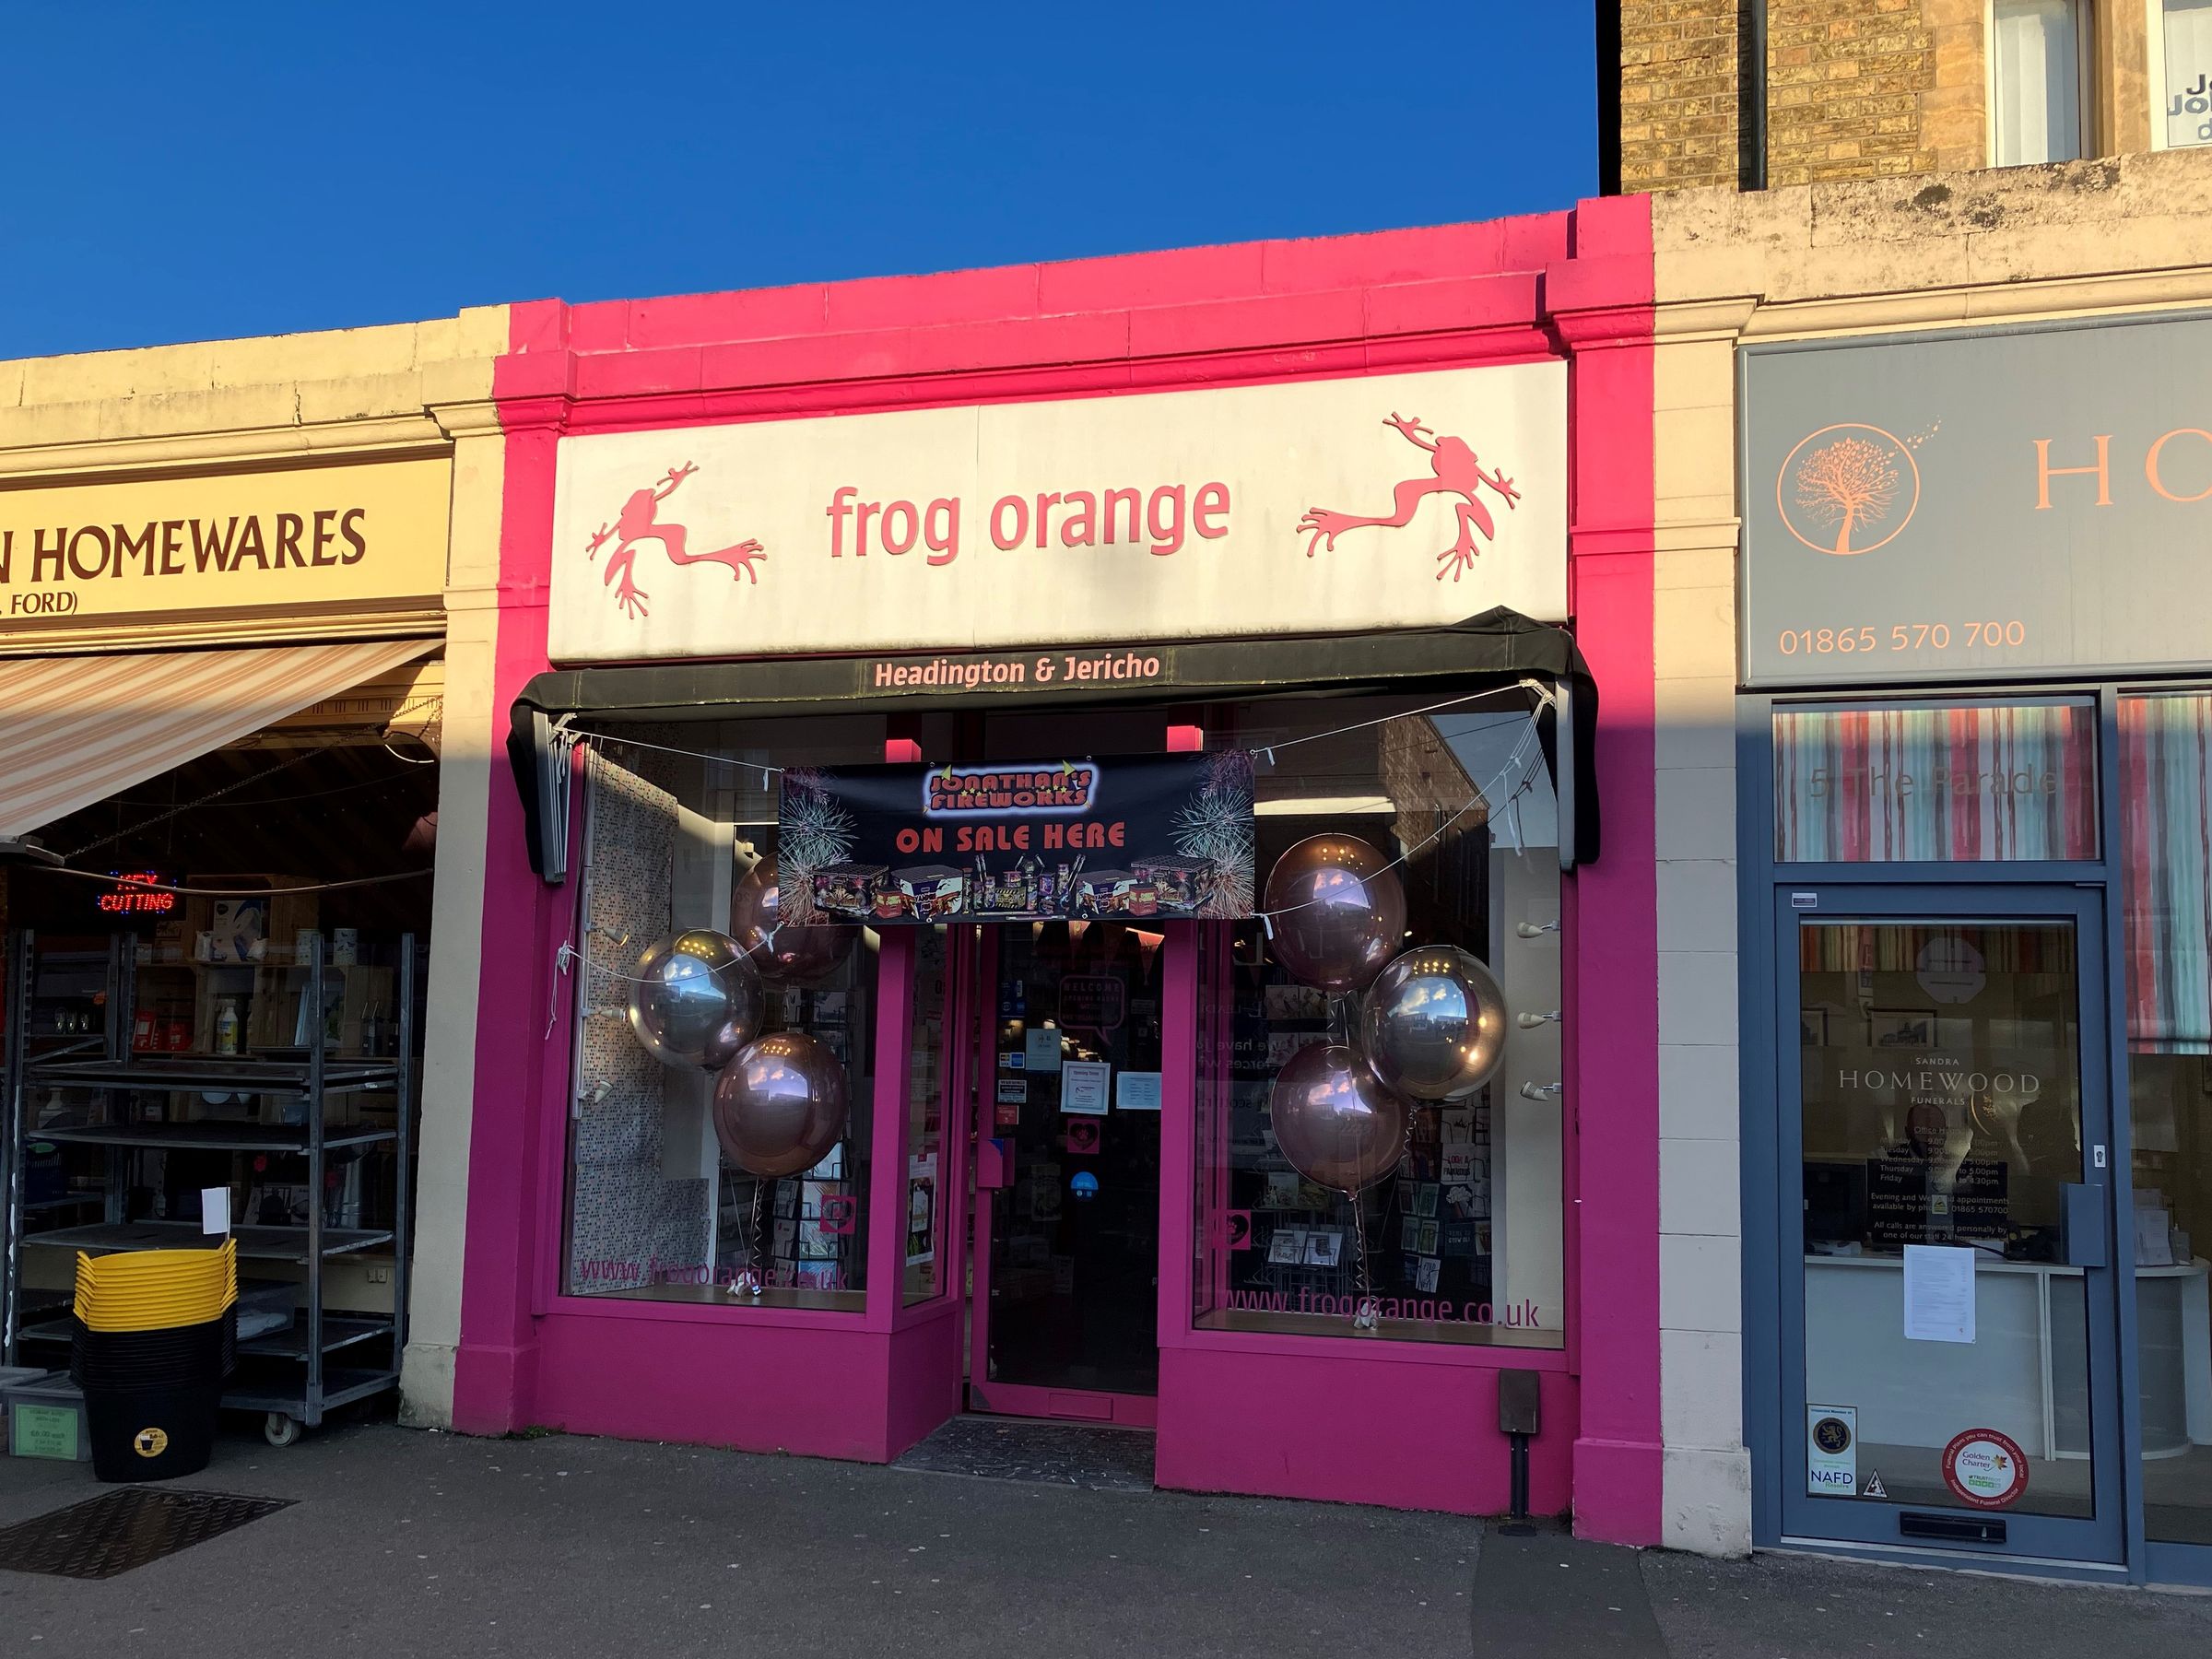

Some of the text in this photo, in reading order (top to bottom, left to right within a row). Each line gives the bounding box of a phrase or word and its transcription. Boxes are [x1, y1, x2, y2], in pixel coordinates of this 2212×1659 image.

[2186, 74, 2212, 96] J
[2168, 94, 2212, 116] Jo
[826, 481, 1231, 567] frog orange
[30, 508, 366, 582] HOMEWARES
[11, 591, 77, 616] FORD)
[1779, 620, 2025, 654] 01865 570 700
[874, 653, 1160, 688] Headington & Jericho
[929, 771, 1092, 793] JONATHAN'S
[1810, 763, 2058, 798] 5 The Parade
[931, 790, 1088, 810] FIREWORKS
[896, 820, 1126, 853] ON SALE HERE
[100, 892, 175, 912] CUTTING
[1915, 1056, 1959, 1066] SANDRA
[1839, 1069, 2040, 1093] HOMEWOOD
[1911, 1096, 1965, 1106] FUNERALS
[1880, 1137, 1911, 1146] Mnday
[1880, 1164, 1913, 1173] Thursday
[1969, 1168, 1998, 1176] 5.00pm
[1880, 1173, 1903, 1182] Friday
[1871, 1192, 1900, 1203] Evening
[1906, 1203, 1915, 1212] by
[1951, 1205, 1975, 1213] 01865
[1978, 1206, 2007, 1214] 570700
[1886, 1221, 1902, 1230] calls
[1956, 1225, 1995, 1234] personally
[1997, 1225, 2007, 1234] by
[1900, 1230, 1908, 1239] of
[1224, 1286, 1539, 1327] www.frogorange.co.uk
[1961, 1458, 1991, 1468] Charter
[1962, 1451, 1991, 1461] Golden
[1810, 1469, 1853, 1485] NAFD
